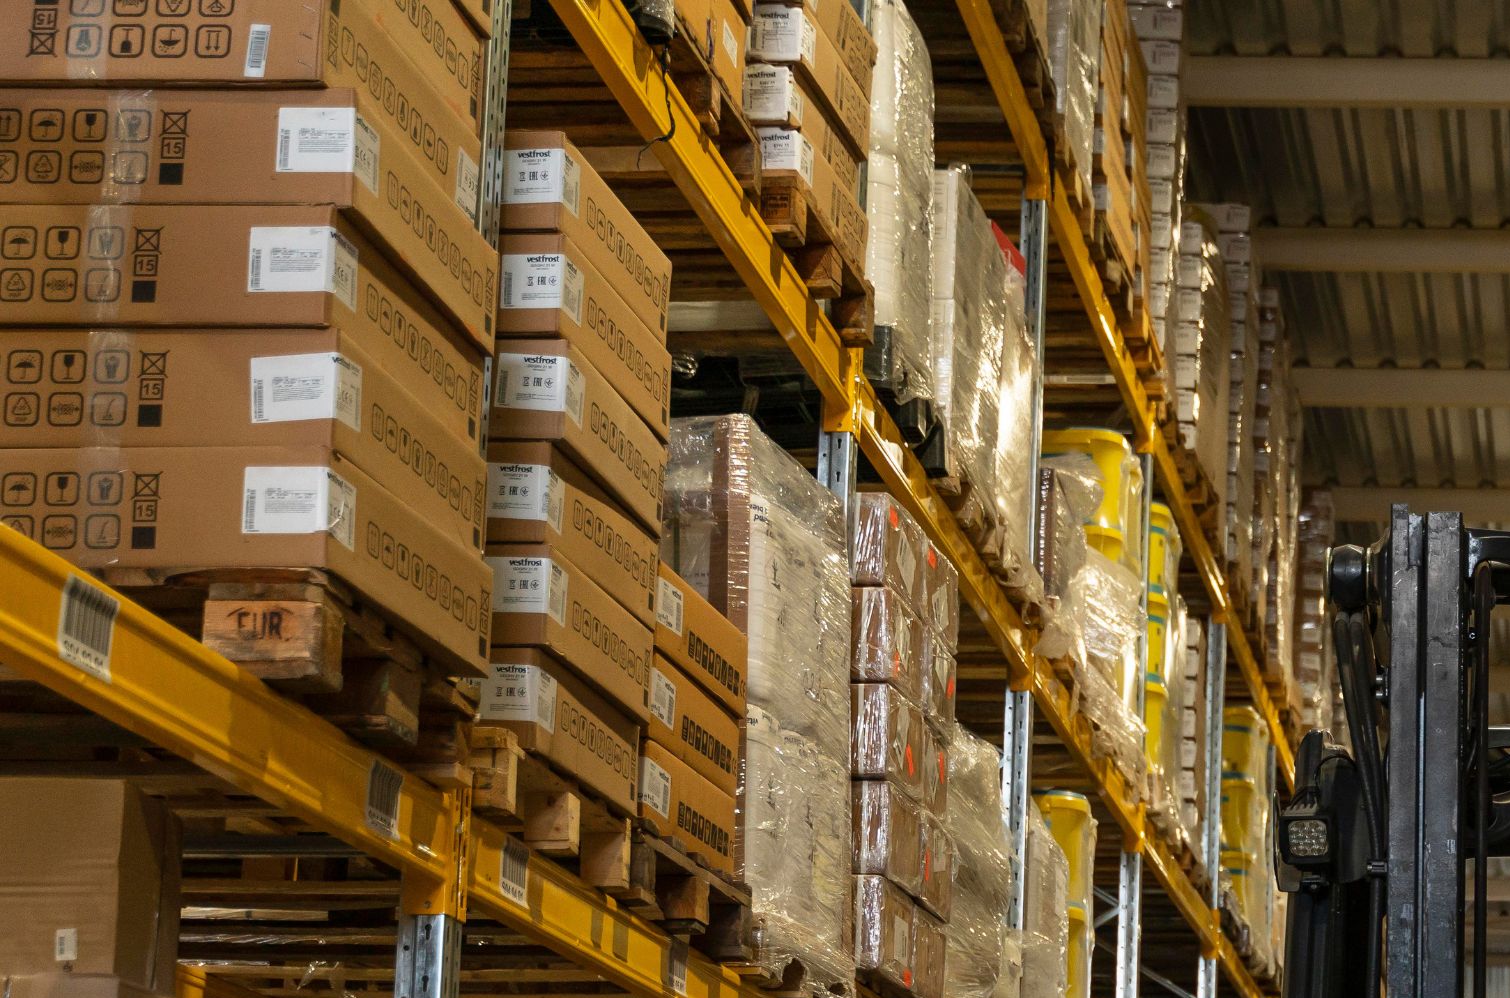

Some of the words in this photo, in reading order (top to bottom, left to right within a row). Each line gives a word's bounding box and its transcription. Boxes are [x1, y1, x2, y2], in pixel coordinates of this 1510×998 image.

[37, 13, 53, 25] 15
[164, 141, 181, 154] 15
[517, 149, 552, 159] vestfrost
[526, 254, 560, 263] vestfrost
[138, 259, 155, 272] 15
[523, 355, 557, 365] vestfrost
[143, 383, 160, 395] 15
[499, 464, 533, 474] vestfrost
[136, 505, 153, 517] 15
[509, 558, 542, 567] vestfrost
[237, 611, 282, 640] EUR
